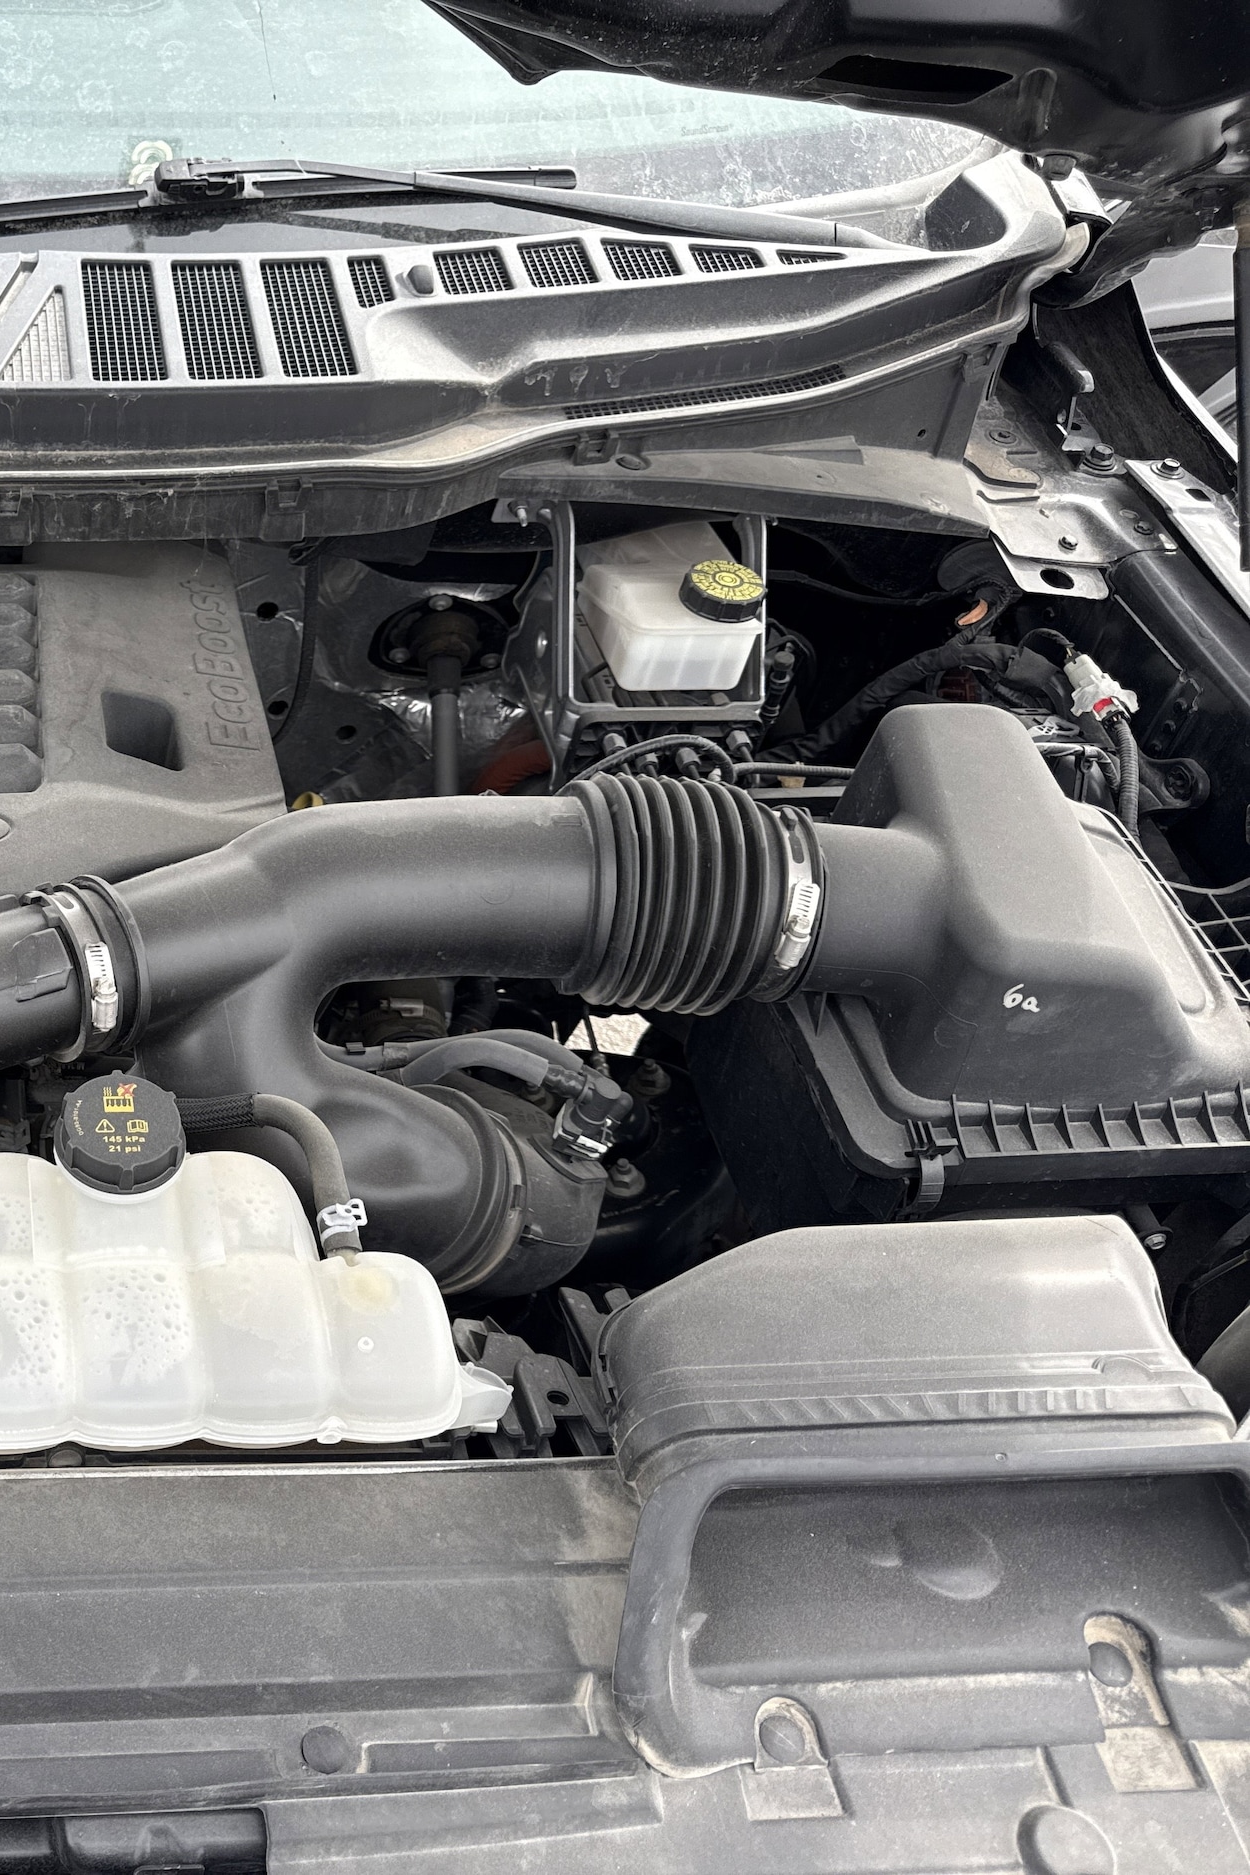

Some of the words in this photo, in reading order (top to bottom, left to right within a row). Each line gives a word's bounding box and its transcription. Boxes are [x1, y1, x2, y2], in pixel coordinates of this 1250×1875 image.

[179, 579, 261, 752] EcoBoost
[102, 1135, 122, 1143] 145
[125, 1135, 146, 1143] kPa
[125, 1145, 141, 1153] psi
